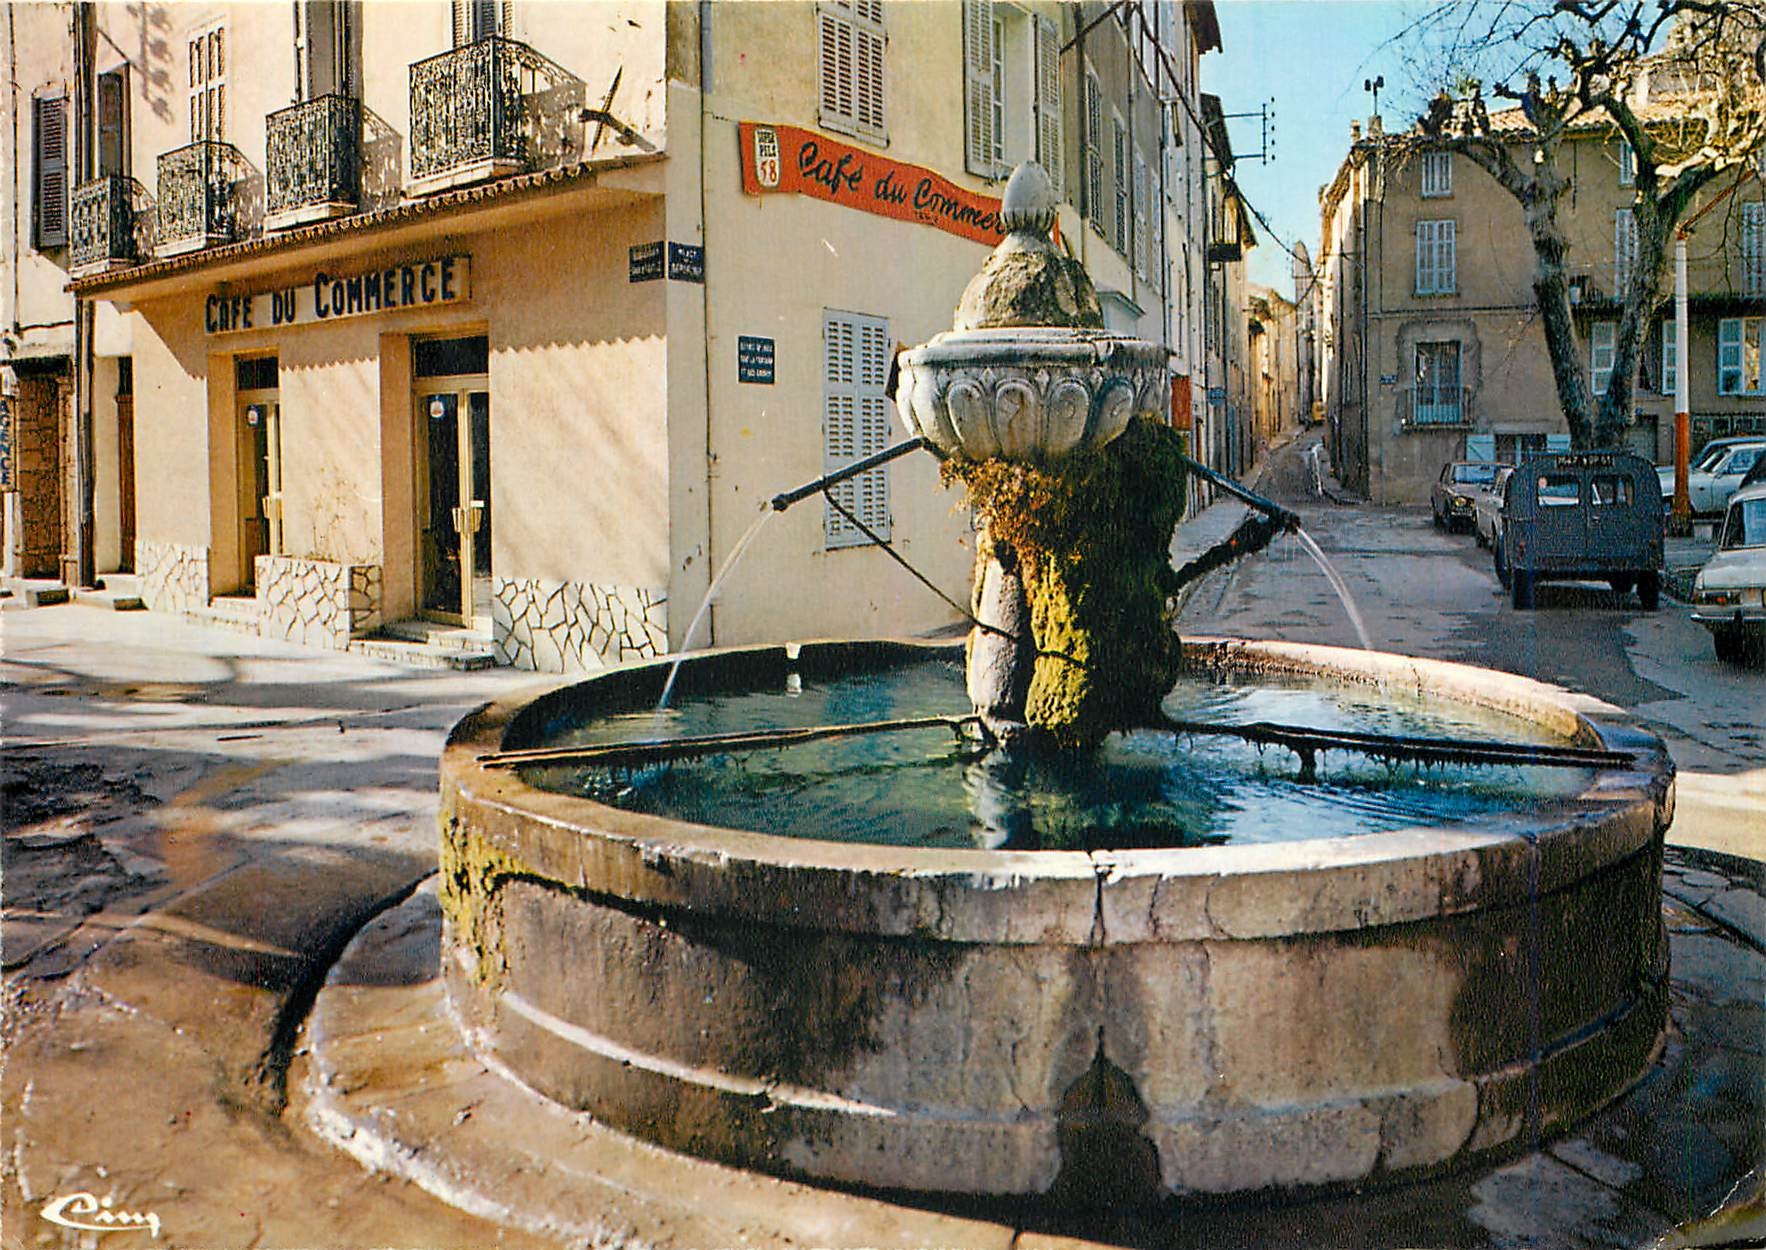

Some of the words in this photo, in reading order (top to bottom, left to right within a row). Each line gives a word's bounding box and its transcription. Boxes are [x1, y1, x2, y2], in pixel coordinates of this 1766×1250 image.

[874, 169, 906, 205] du
[271, 286, 296, 325] DU
[313, 256, 456, 319] COMMERCE
